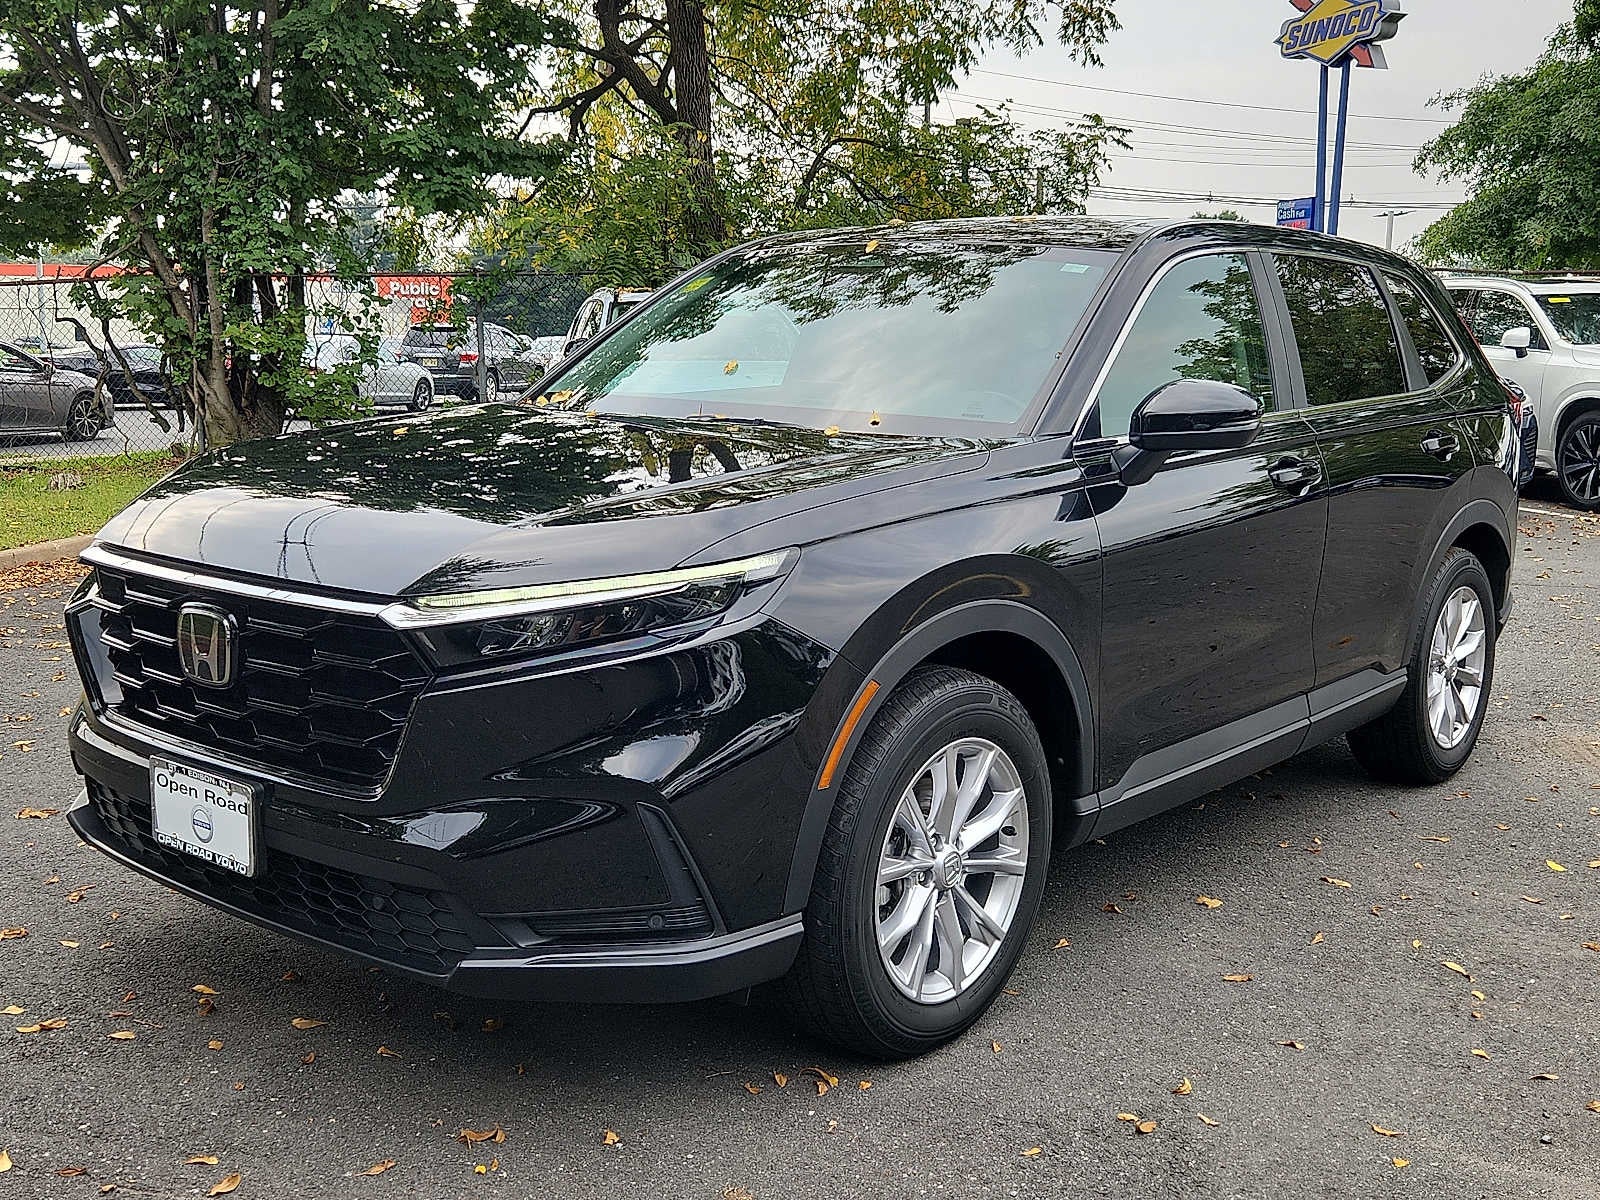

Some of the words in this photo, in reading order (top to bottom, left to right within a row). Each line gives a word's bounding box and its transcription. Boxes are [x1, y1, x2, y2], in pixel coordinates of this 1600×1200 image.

[1285, 5, 1376, 50] SUNOCO
[1278, 207, 1296, 220] Cash
[389, 280, 441, 296] Public
[156, 773, 198, 799] Open
[204, 789, 248, 815] Road
[157, 833, 184, 850] OPEN
[185, 843, 213, 861] ROAD
[215, 853, 247, 875] VOLVO
